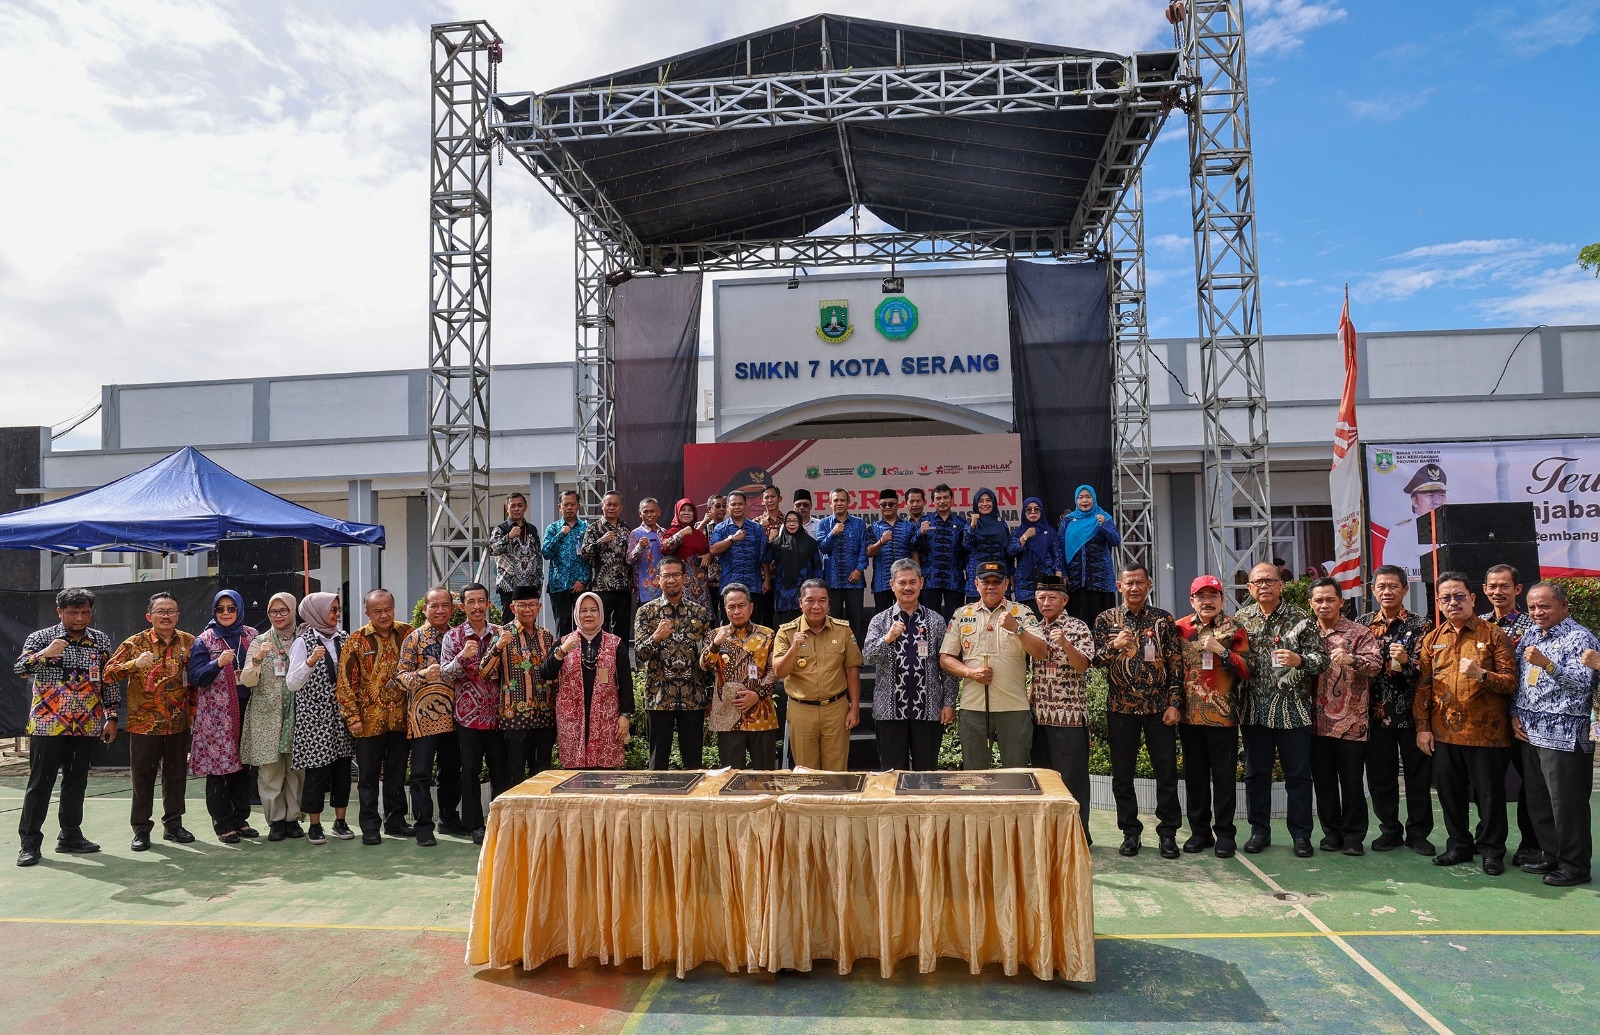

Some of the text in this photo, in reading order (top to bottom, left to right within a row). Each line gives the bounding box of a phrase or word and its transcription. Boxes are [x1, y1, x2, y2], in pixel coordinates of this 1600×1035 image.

[734, 353, 1000, 380] SMKN 7 KOTA SERANG
